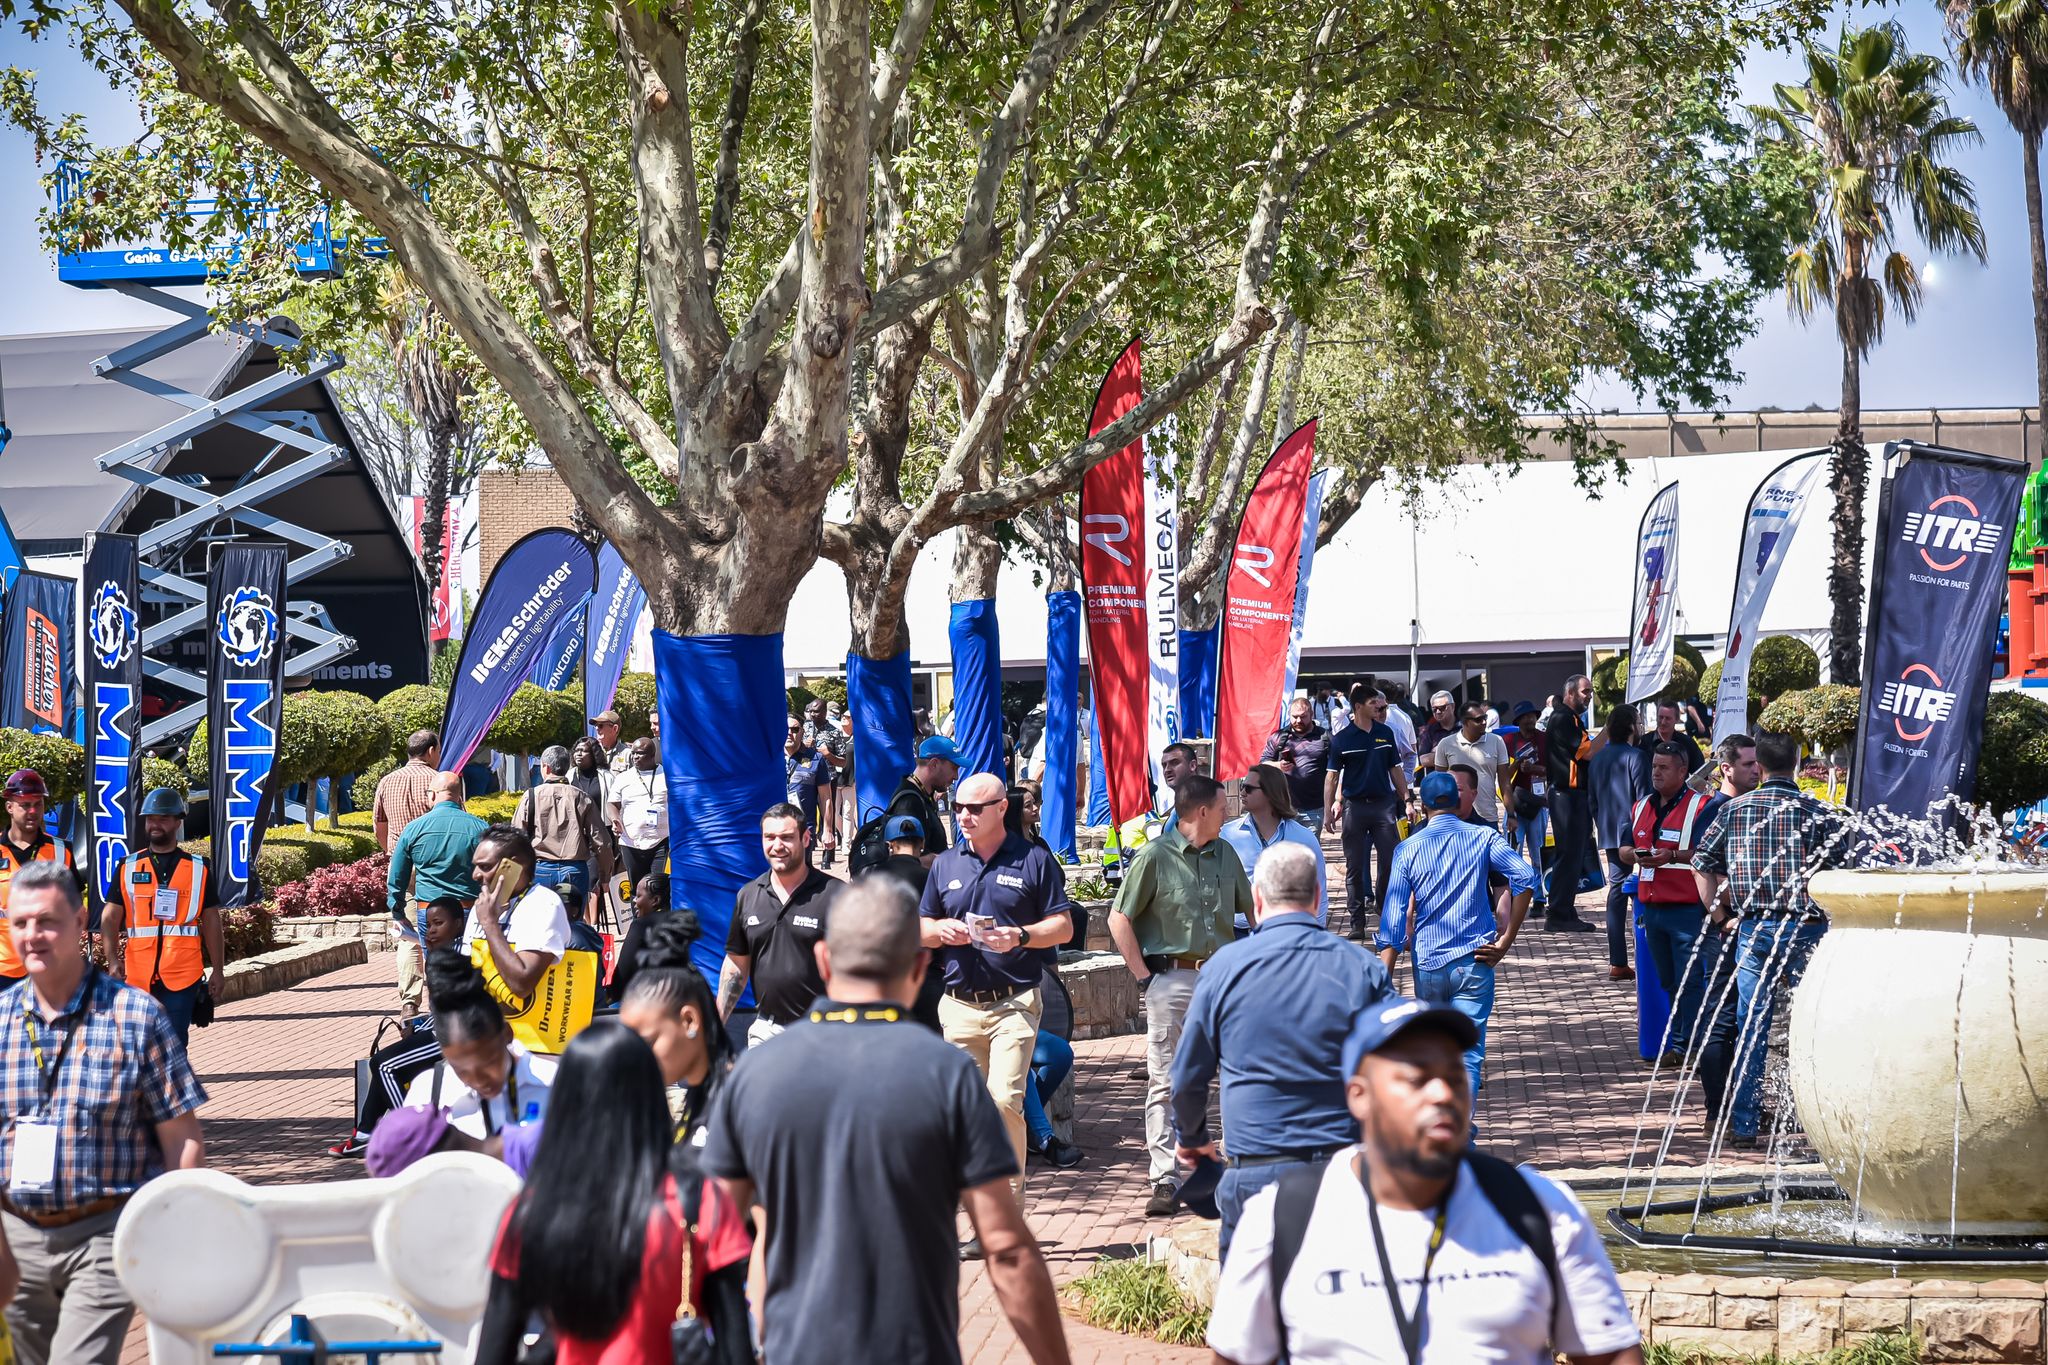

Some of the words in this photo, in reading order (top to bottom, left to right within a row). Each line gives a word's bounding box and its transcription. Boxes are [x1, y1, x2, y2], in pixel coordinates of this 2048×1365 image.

[124, 251, 163, 264] Genie
[1915, 513, 1981, 553] ITR
[1087, 585, 1137, 595] PREMIUM
[1156, 508, 1177, 658] RULMECA
[1909, 573, 1937, 585] PASSION
[1936, 577, 1950, 587] FOR
[1950, 579, 1970, 590] PARTS
[1088, 598, 1145, 609] COMPONEN
[1103, 608, 1131, 616] MATERIAL
[1229, 607, 1290, 622] COMPONENTS
[1230, 597, 1272, 610] PREMIUM
[1228, 621, 1254, 630] HANDLING
[1239, 616, 1264, 625] MATERIAL
[501, 642, 527, 673] Experts
[523, 633, 532, 644] in
[609, 628, 621, 654] Experts
[29, 621, 59, 712] Fletcher
[311, 661, 393, 680] ments
[546, 637, 579, 692] CONCORD
[34, 656, 42, 708] EQUIPMENT
[1892, 683, 1946, 723] ITR
[538, 968, 556, 1032] Dromex
[558, 987, 573, 1043] WORKWEAR
[567, 961, 575, 978] PPE
[1314, 1268, 1519, 1296] Chmpion
